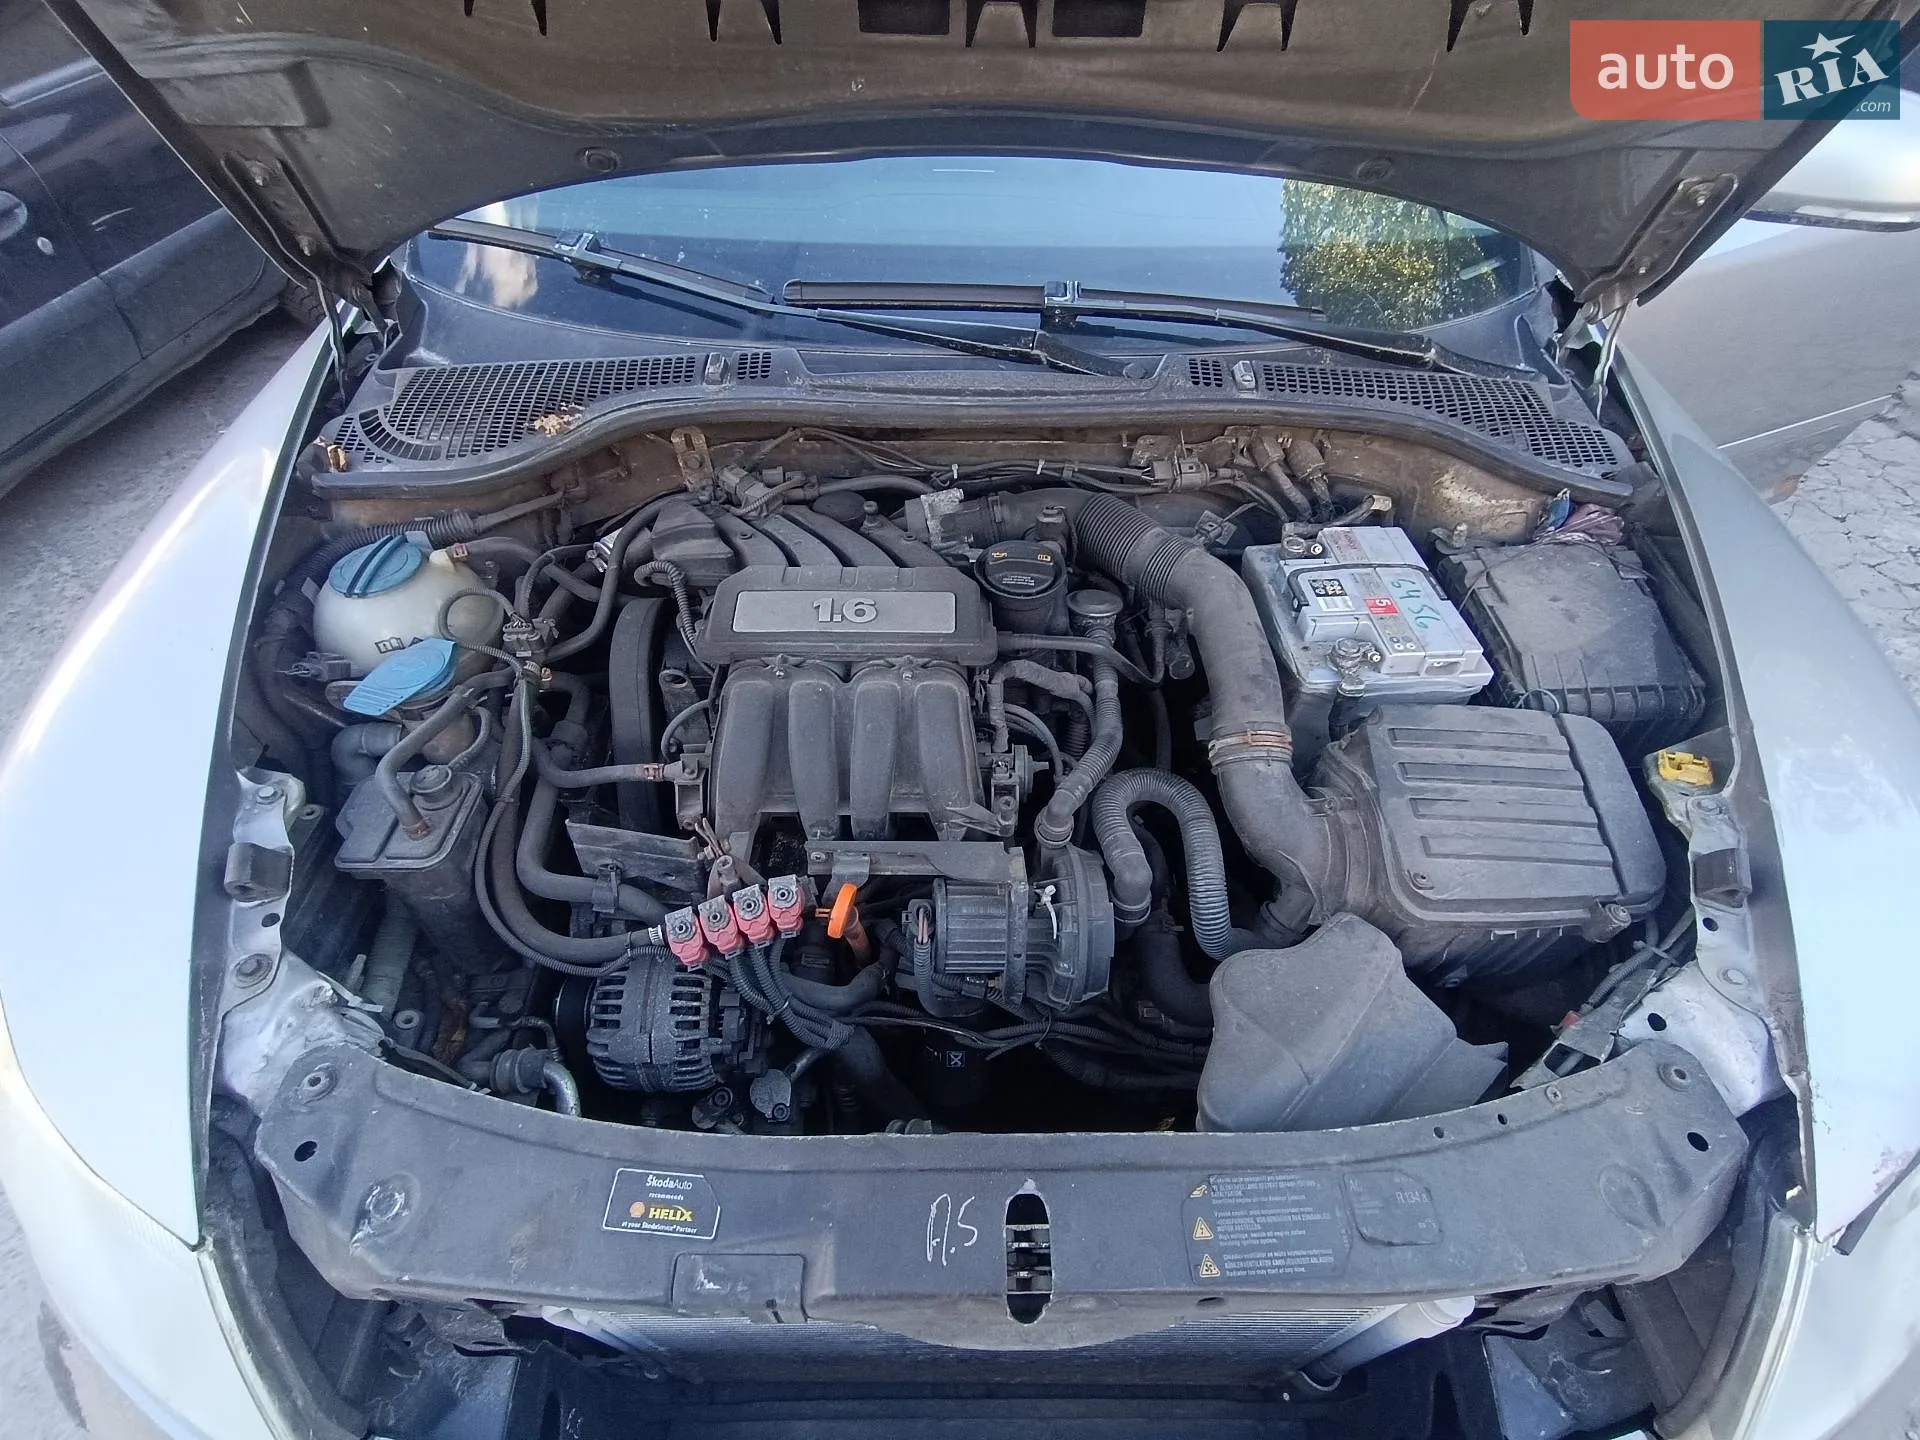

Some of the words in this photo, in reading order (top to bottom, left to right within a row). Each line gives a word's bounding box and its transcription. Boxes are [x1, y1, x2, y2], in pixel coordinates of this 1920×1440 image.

[813, 597, 878, 623] 1.6
[648, 1205, 693, 1222] HELIX
[676, 1226, 698, 1234] Partner
